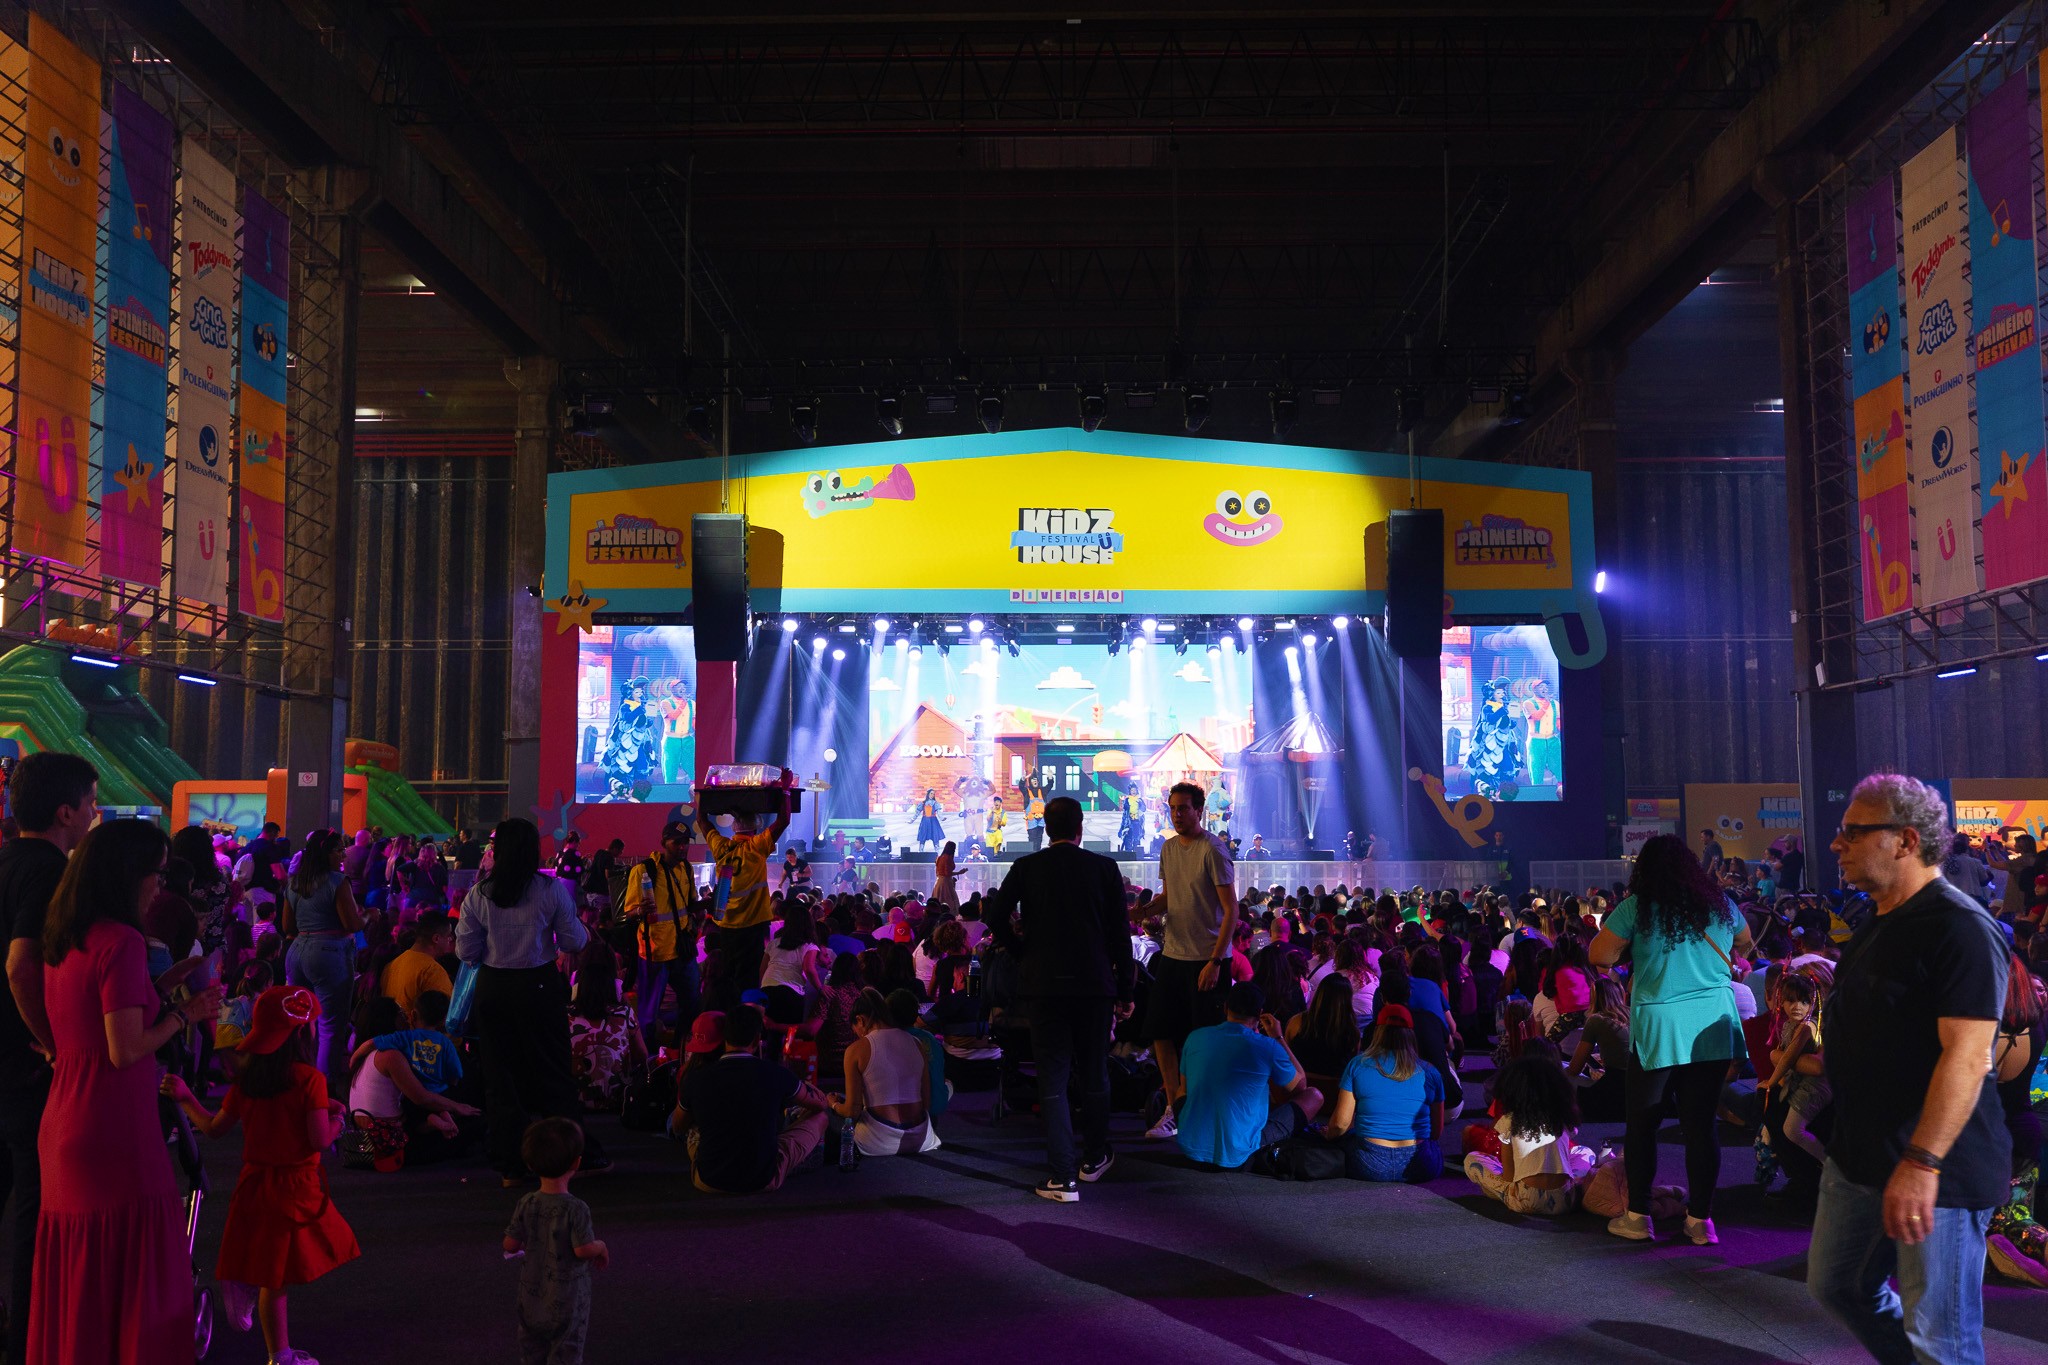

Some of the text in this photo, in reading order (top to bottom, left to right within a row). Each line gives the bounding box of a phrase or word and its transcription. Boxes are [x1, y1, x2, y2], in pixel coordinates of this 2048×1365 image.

[193, 196, 227, 227] PATROCÍNIO
[1912, 201, 1948, 234] PATROCÍNIO
[1911, 235, 1955, 299] Toddynho
[110, 307, 166, 348] PRIMEIRO
[1917, 318, 1957, 355] Maria
[1977, 308, 2033, 351] PRIMEIRO
[1914, 374, 1963, 408] POLENGUINHO
[588, 529, 680, 546] PRIMEIRO
[1041, 535, 1095, 543] FESTIVAL
[1457, 529, 1550, 546] PRIMEIRO
[1018, 545, 1114, 565] HOUSE
[1012, 590, 1120, 600] DIVERSÃO
[900, 745, 965, 758] ESCOLA
